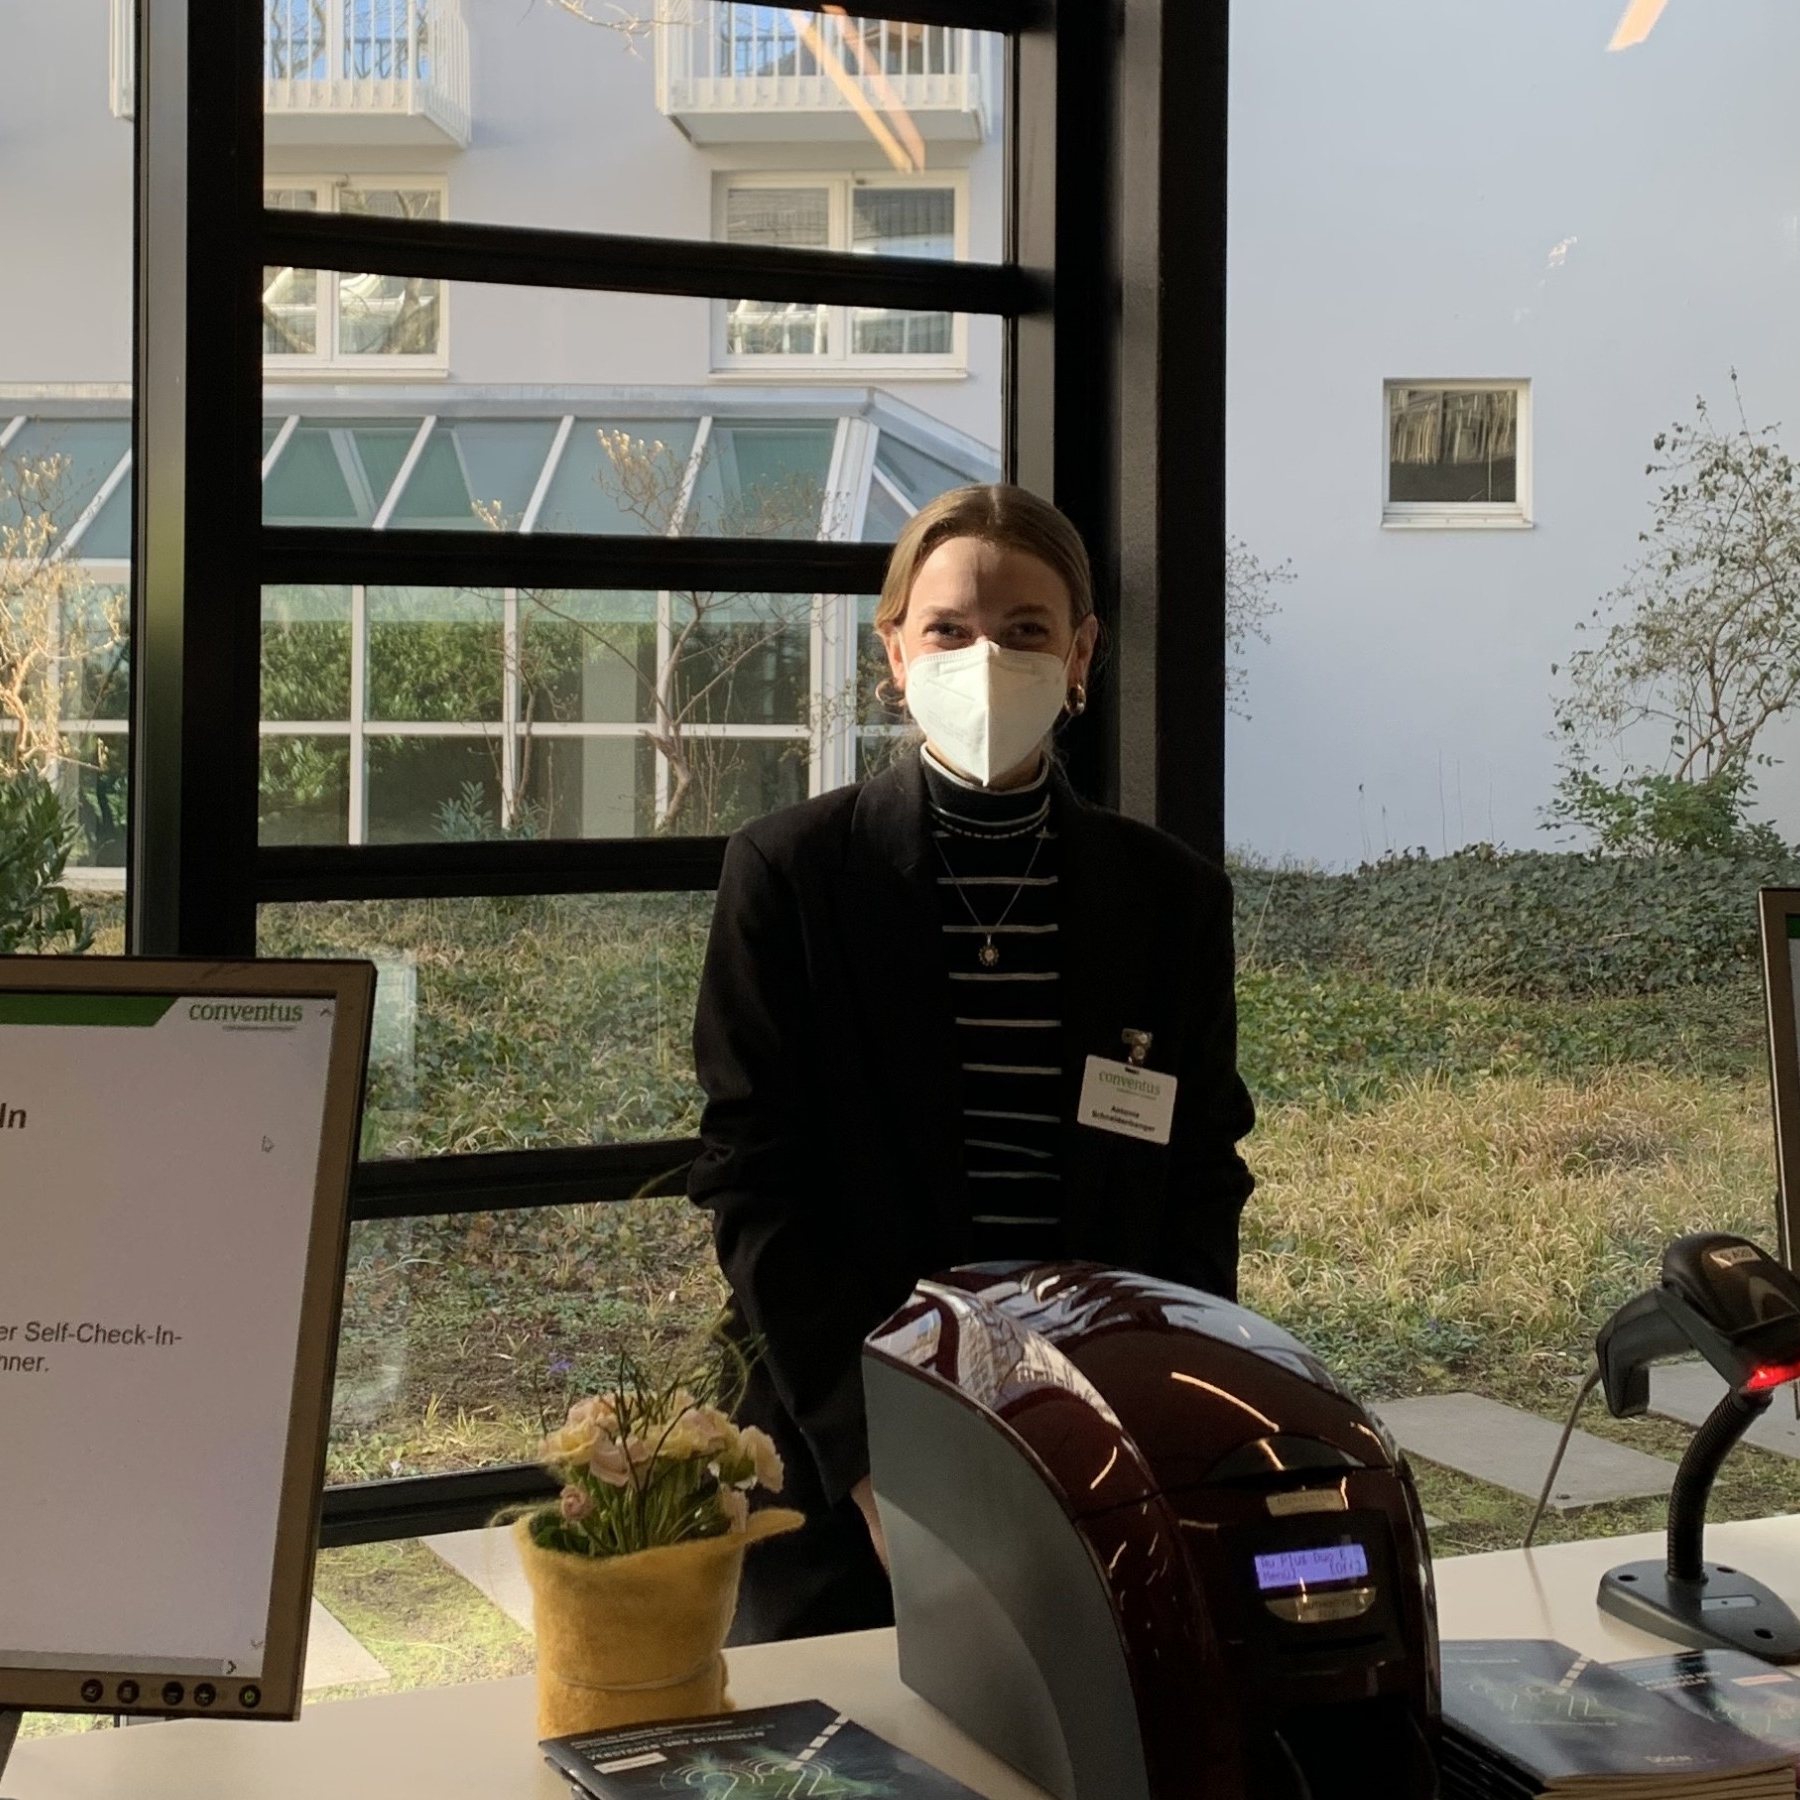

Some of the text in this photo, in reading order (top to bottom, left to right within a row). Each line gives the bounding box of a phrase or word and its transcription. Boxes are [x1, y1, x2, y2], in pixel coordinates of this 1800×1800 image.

[189, 1000, 303, 1022] conventus
[1098, 1071, 1161, 1096] conventus
[25, 1321, 182, 1346] Self-Check-In-
